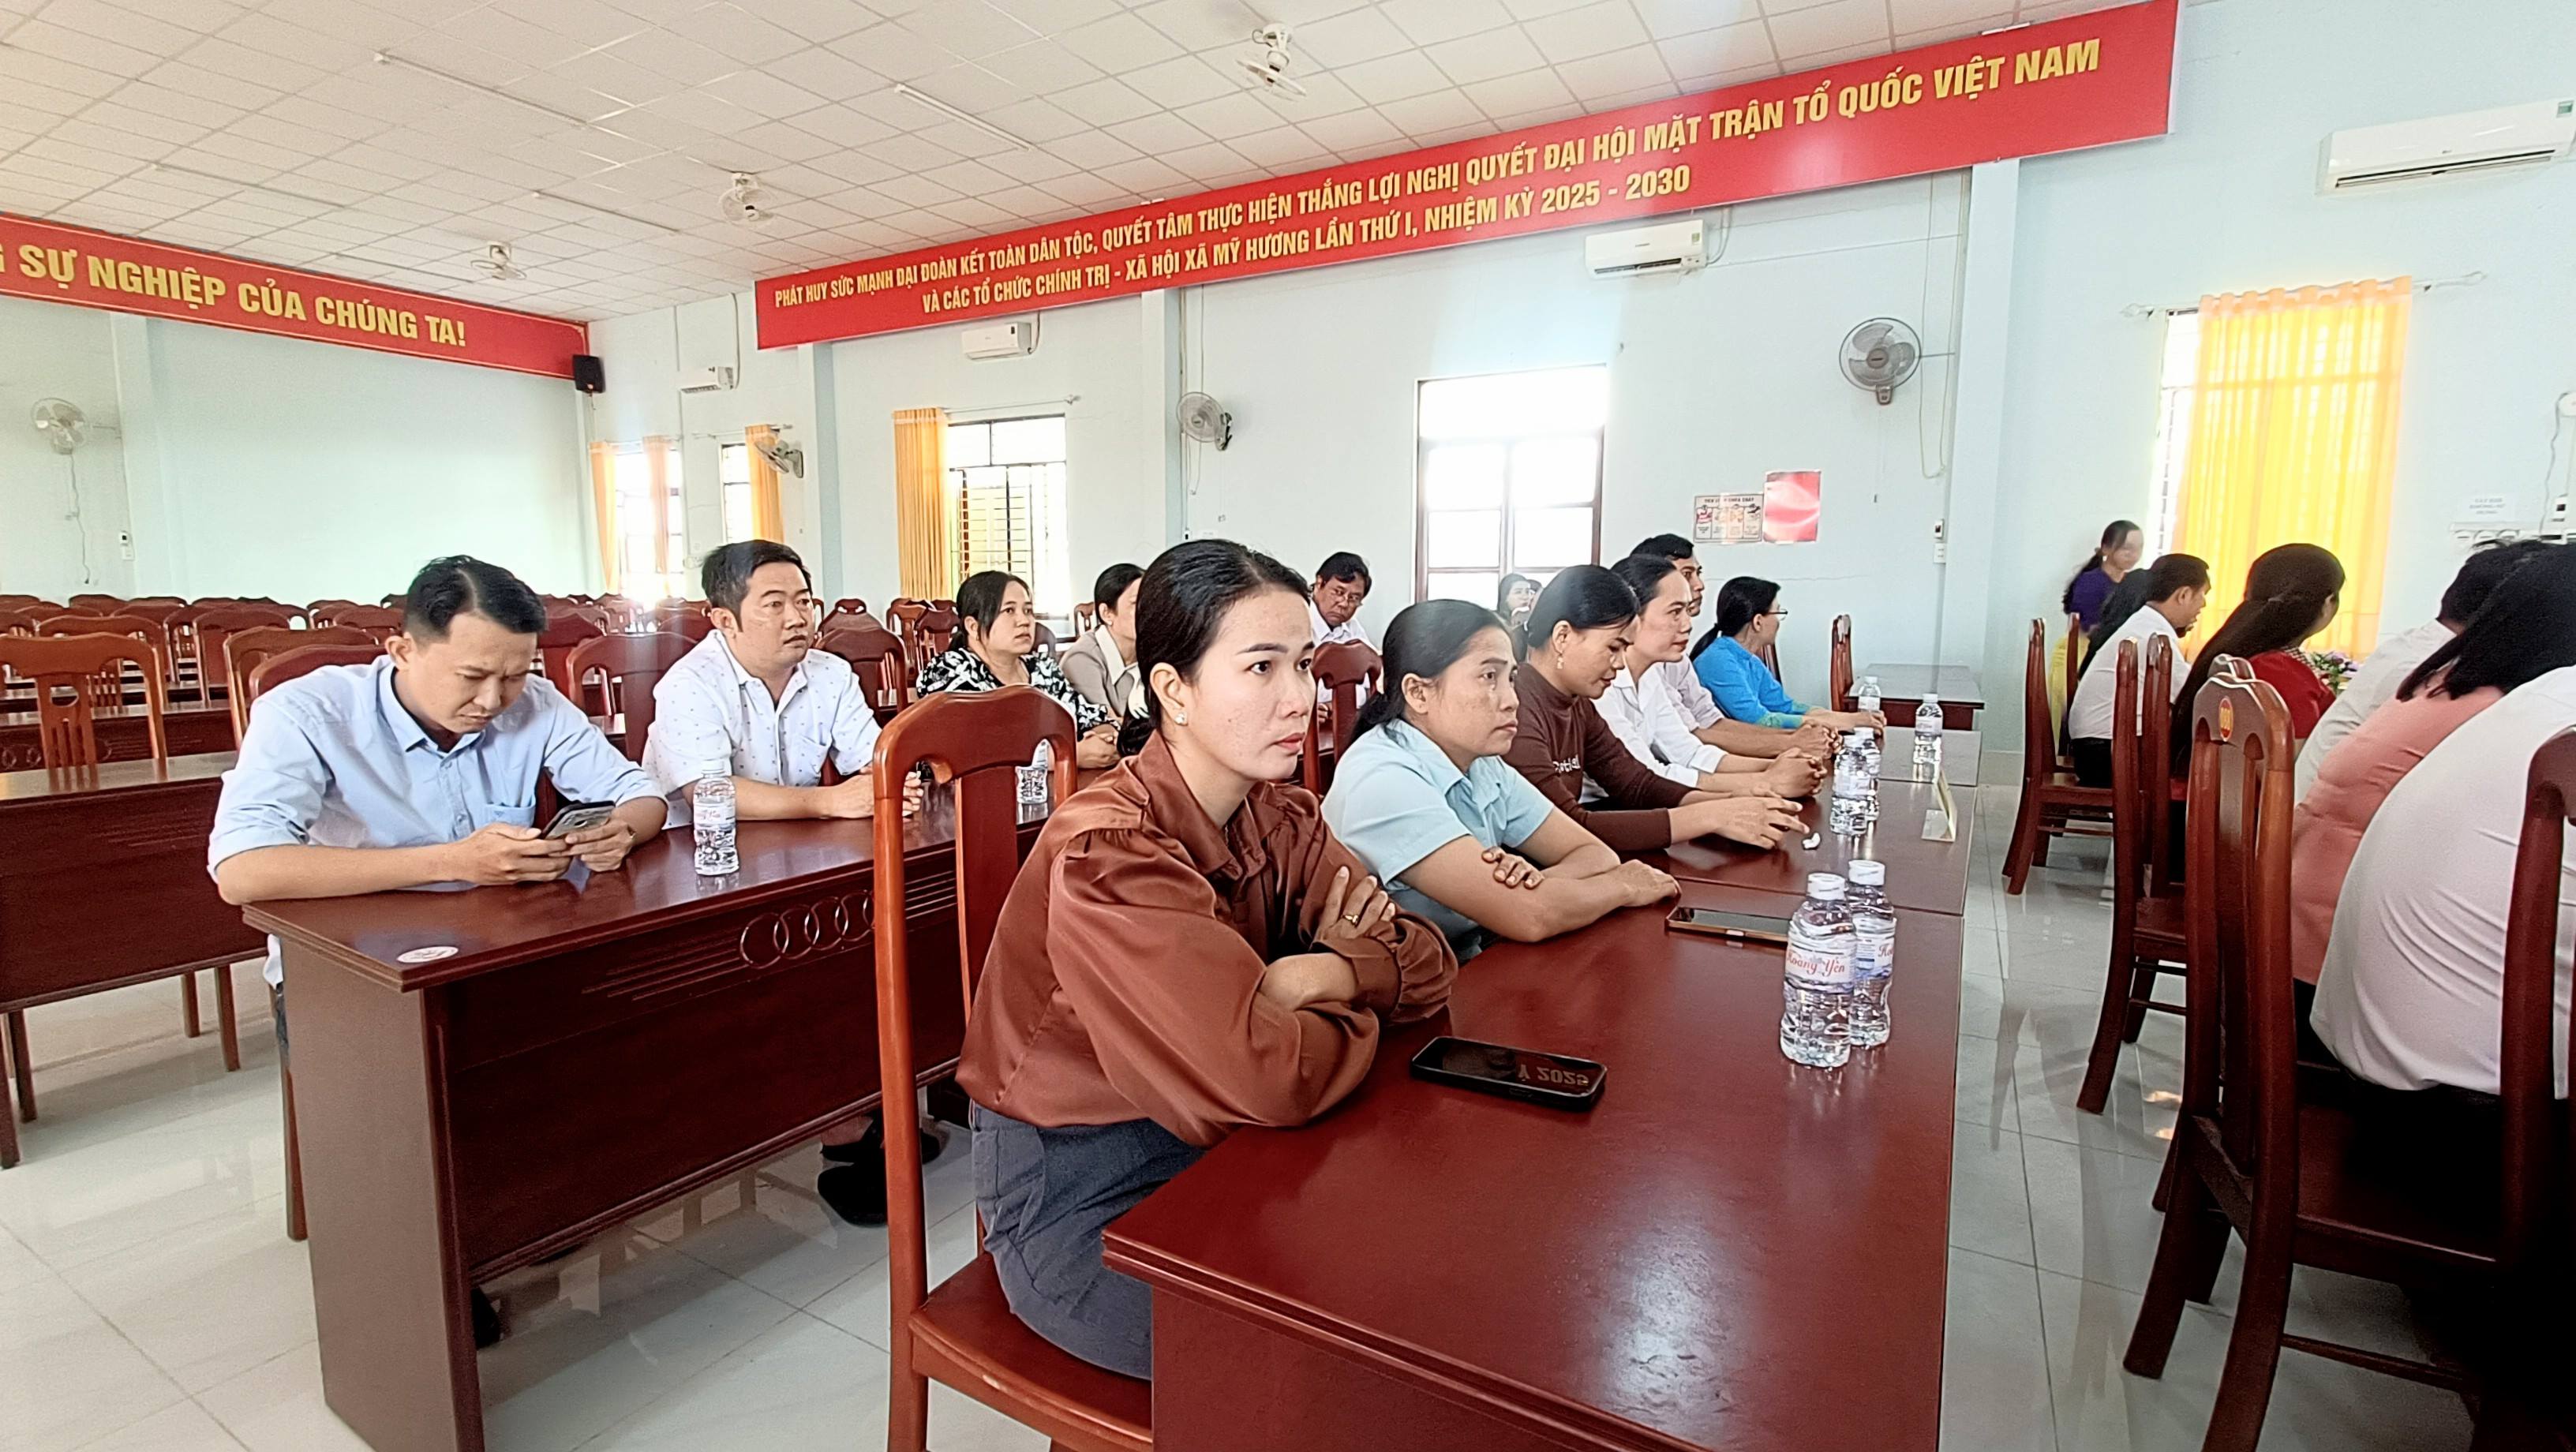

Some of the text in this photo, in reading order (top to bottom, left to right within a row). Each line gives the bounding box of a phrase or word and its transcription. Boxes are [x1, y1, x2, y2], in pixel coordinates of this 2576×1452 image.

[776, 285, 803, 307] PHÁT
[806, 283, 827, 302] HUY
[831, 275, 853, 298] SỨC
[857, 270, 893, 295] MẠNH
[960, 249, 985, 275] KẾT
[989, 245, 1025, 270] TOÀN
[1030, 238, 1060, 263] DÂN
[1065, 230, 1097, 259] TỘC,
[1103, 216, 1151, 251] QUYẾT
[1157, 212, 1192, 239] TÂM
[1198, 203, 1242, 232] THỰC
[1249, 193, 1291, 224] HIỆN
[1297, 178, 1361, 214] THẮNG
[1369, 172, 1399, 204] LỢI
[1407, 163, 1458, 194] NGHỊ
[1466, 141, 1537, 185] QUYẾT
[1544, 139, 1585, 172] ĐẠI
[1593, 126, 1635, 163] HỘI
[1644, 114, 1701, 152] MẶT
[1709, 99, 1784, 140] TRẬN
[1793, 80, 1830, 124] TỔ
[1839, 66, 1922, 118] QUỐC
[1934, 56, 2005, 99] VIỆT
[2015, 39, 2099, 84] NAM
[923, 290, 940, 312] VÀ
[944, 286, 969, 309] CÁC
[973, 277, 990, 305] TỔ
[994, 275, 1031, 301] CHỨC
[1036, 268, 1080, 294] CHÍNH
[1085, 264, 1109, 288] TRỊ
[1126, 254, 1147, 280] XÃ
[1152, 249, 1179, 279] HỘI
[1185, 243, 1208, 271] XÃ
[1214, 238, 1240, 265] MỸ
[1246, 230, 1309, 260] HƯƠNG
[1316, 217, 1353, 249] LẦN
[1360, 210, 1401, 242] THỨ
[1425, 196, 1497, 232] NHIỆM
[1505, 186, 1534, 219] KỲ
[1541, 181, 1600, 213] 2025
[1625, 166, 1689, 200] 2030
[20, 245, 77, 289] SỰ
[88, 254, 226, 309] NGHIỆP
[238, 279, 306, 320] CỦA
[316, 297, 417, 339] CHÚNG
[425, 316, 465, 346] TA!
